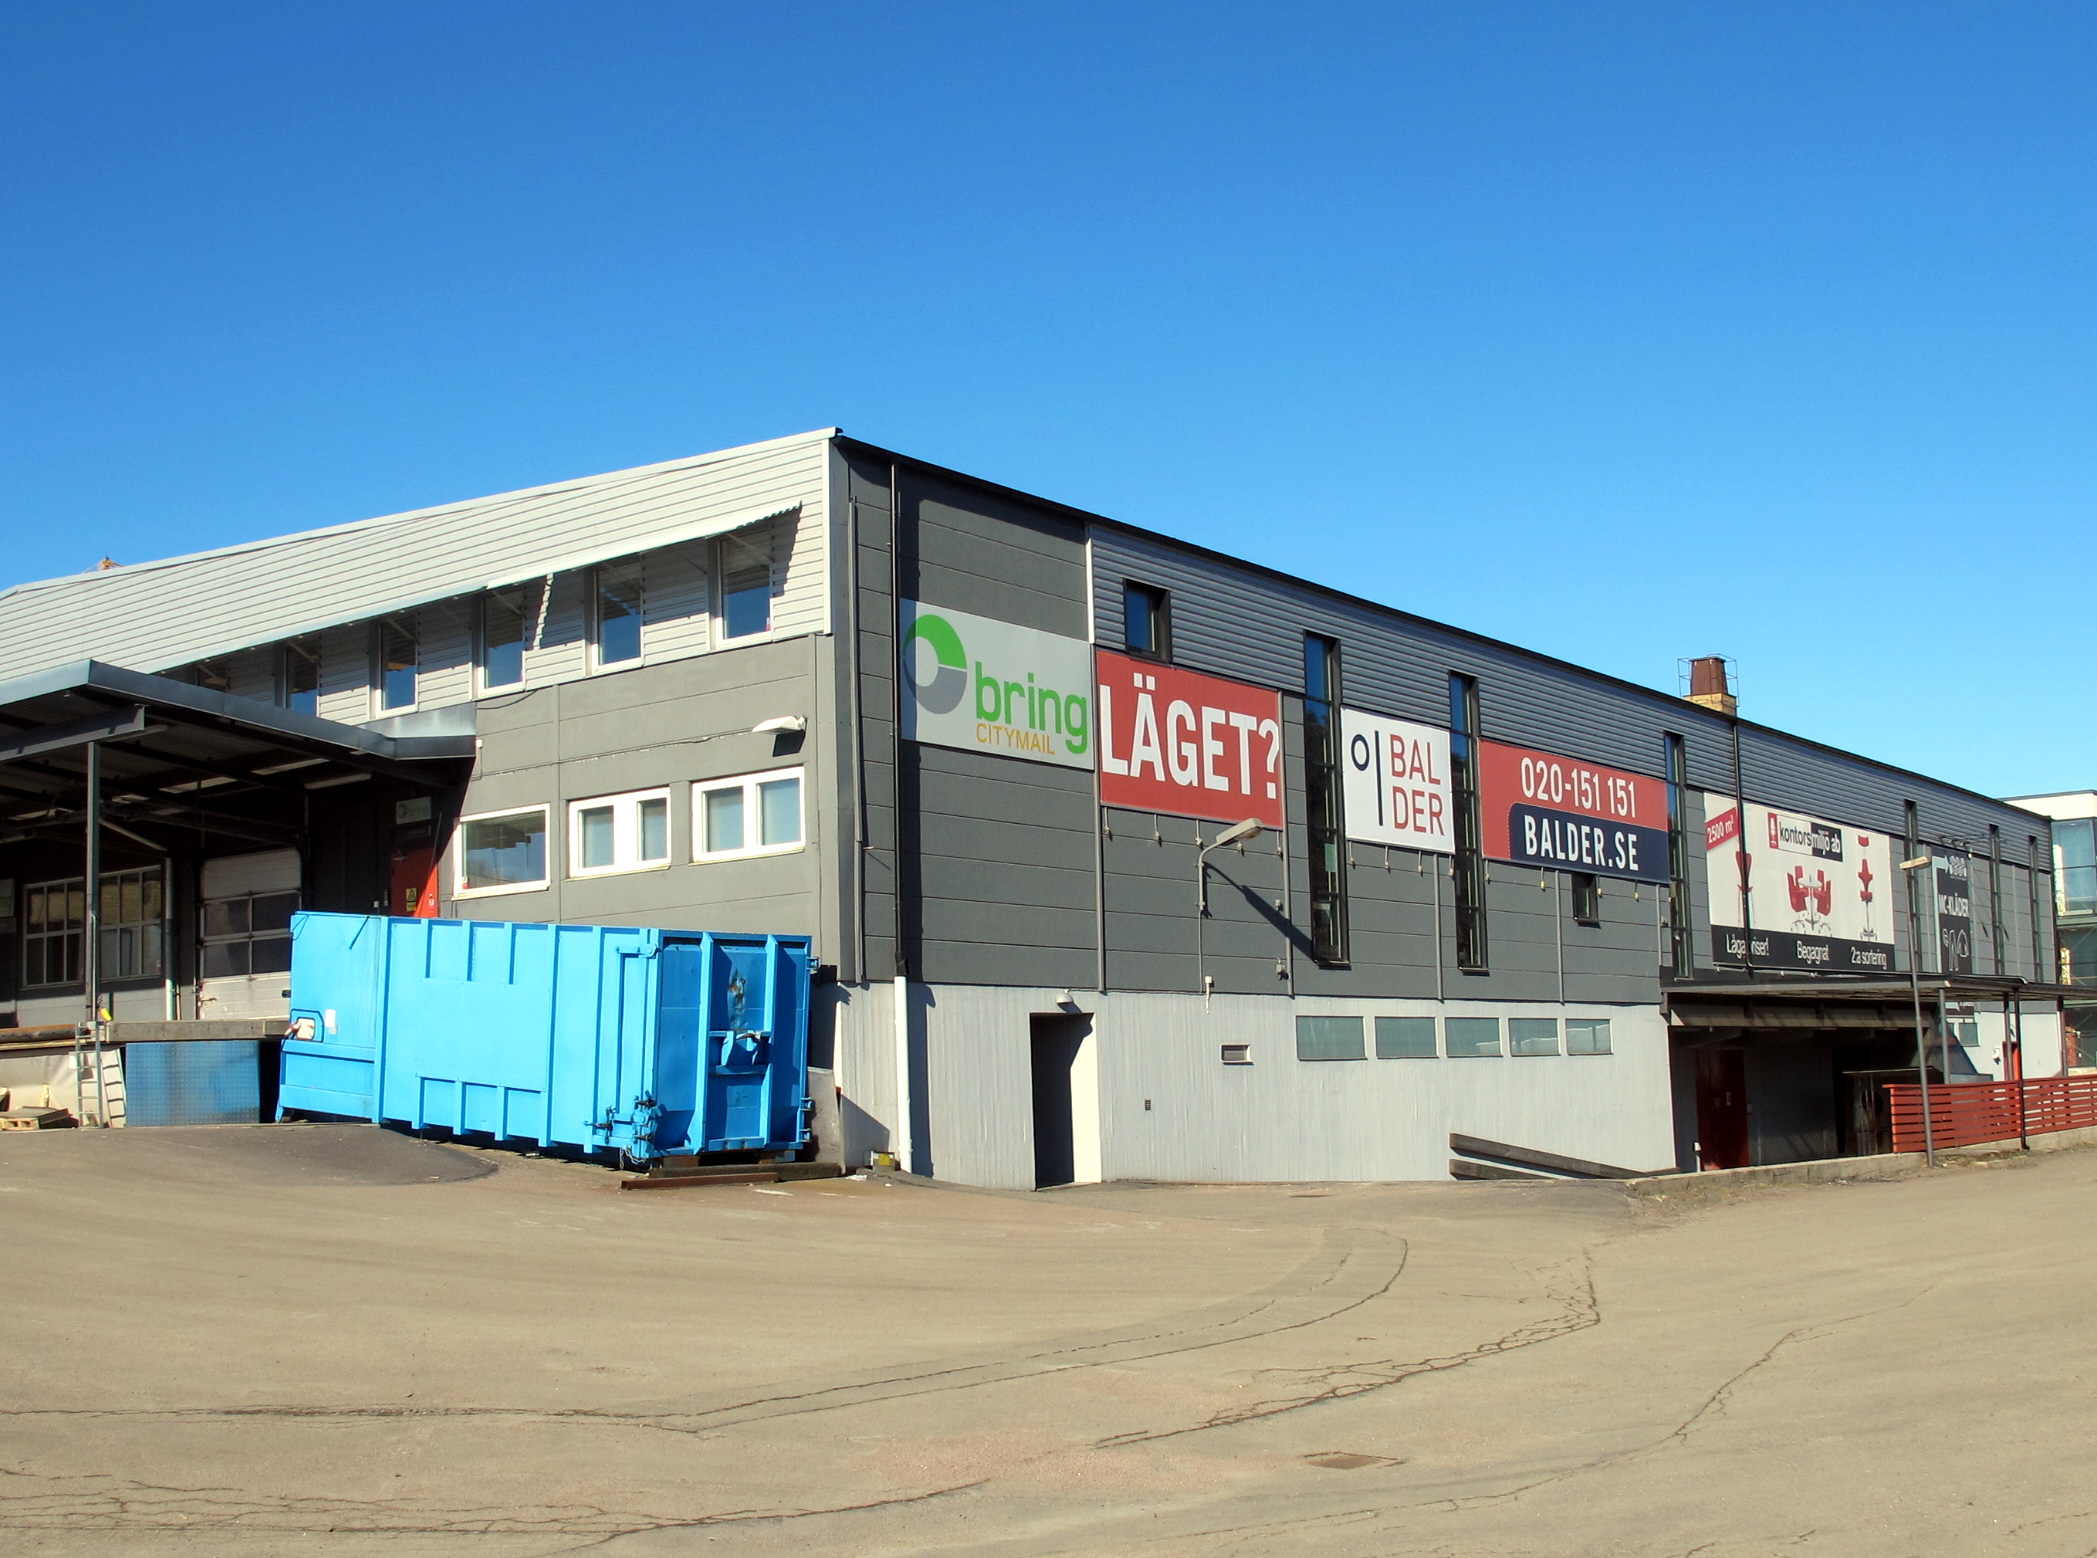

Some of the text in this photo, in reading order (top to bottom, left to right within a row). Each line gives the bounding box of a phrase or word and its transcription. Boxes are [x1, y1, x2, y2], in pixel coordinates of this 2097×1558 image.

[974, 661, 1088, 755] bring
[975, 722, 1056, 756] CITYMAIL
[1099, 673, 1281, 800] LÄGET?
[1389, 733, 1442, 785] BAL
[1391, 786, 1445, 837] DER
[1520, 756, 1637, 818] 020-151 151
[1523, 813, 1640, 872] BALDER.SE
[1706, 821, 1725, 844] 2500
[1749, 936, 1770, 957] riser!
[1796, 940, 1830, 965] Begagnat
